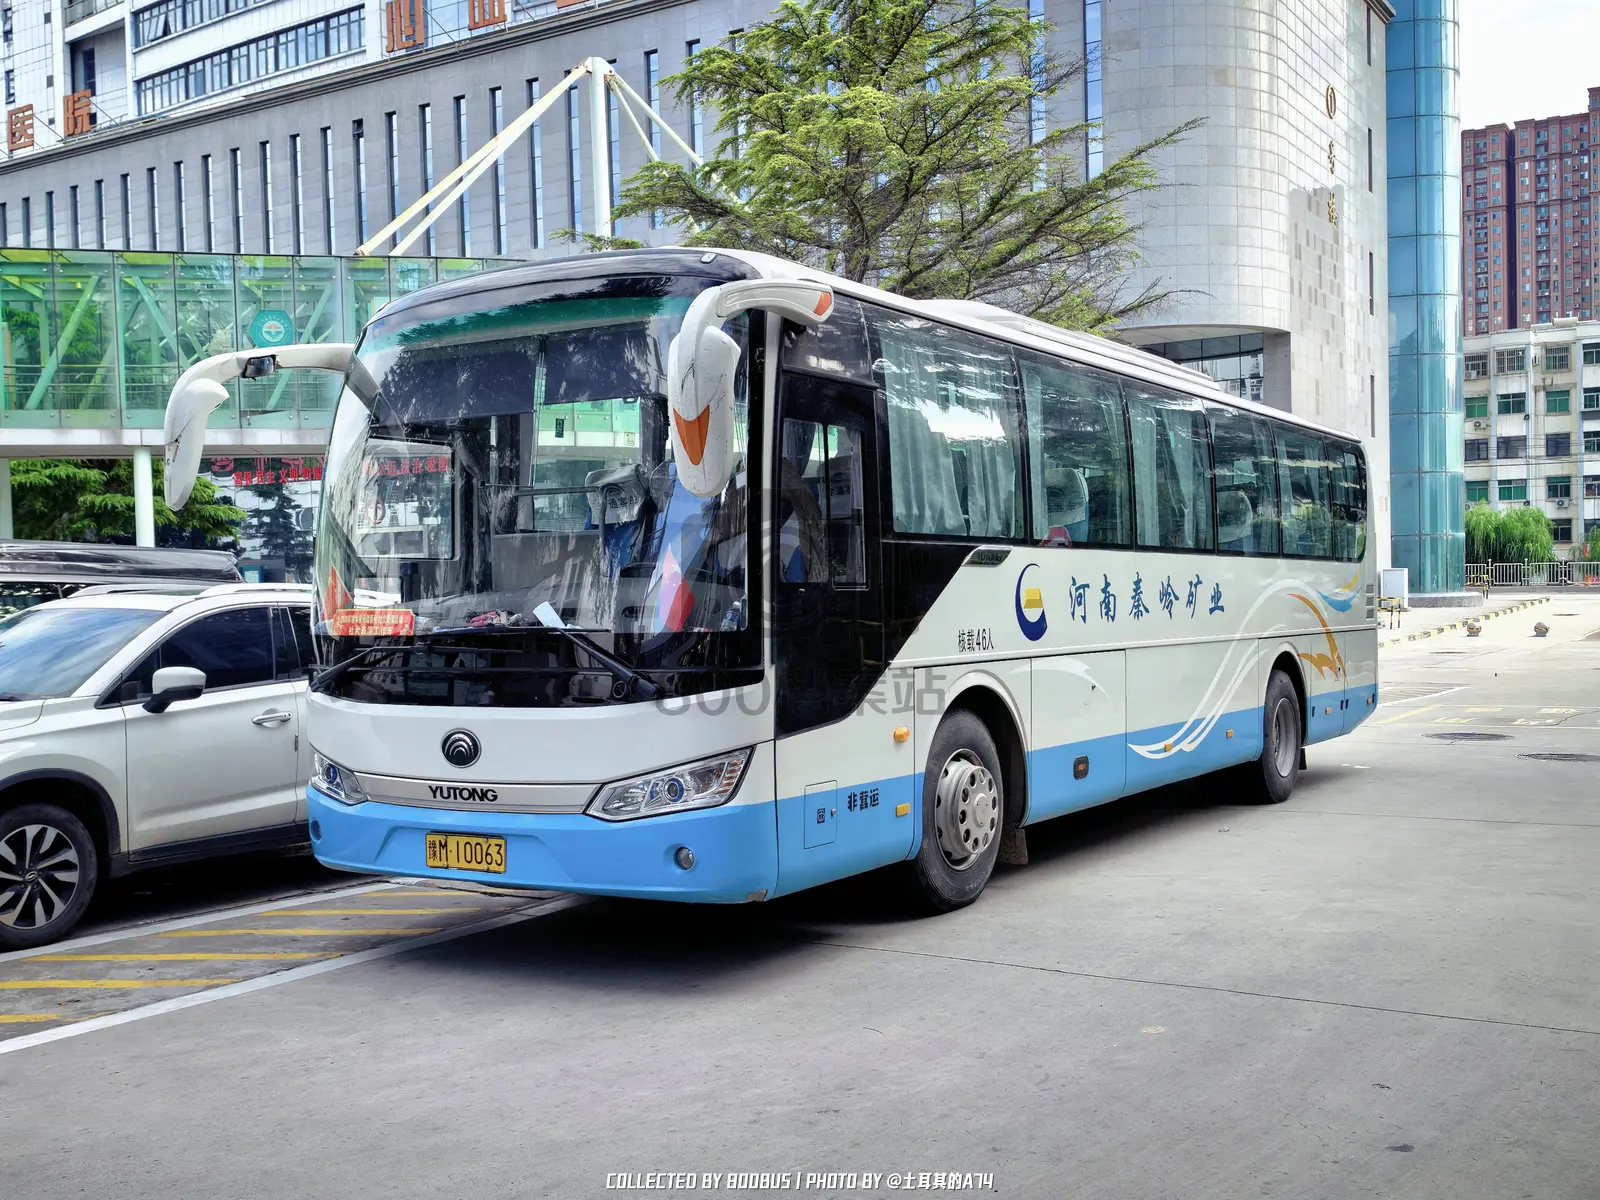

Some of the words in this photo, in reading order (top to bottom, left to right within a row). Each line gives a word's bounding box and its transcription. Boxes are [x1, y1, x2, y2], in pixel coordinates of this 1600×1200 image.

[8, 89, 91, 151] 医院
[1069, 571, 1225, 624] 河南秦岭矿业
[958, 628, 994, 652] 核载46人
[428, 785, 498, 802] YUTONG
[847, 788, 880, 812] 非营运
